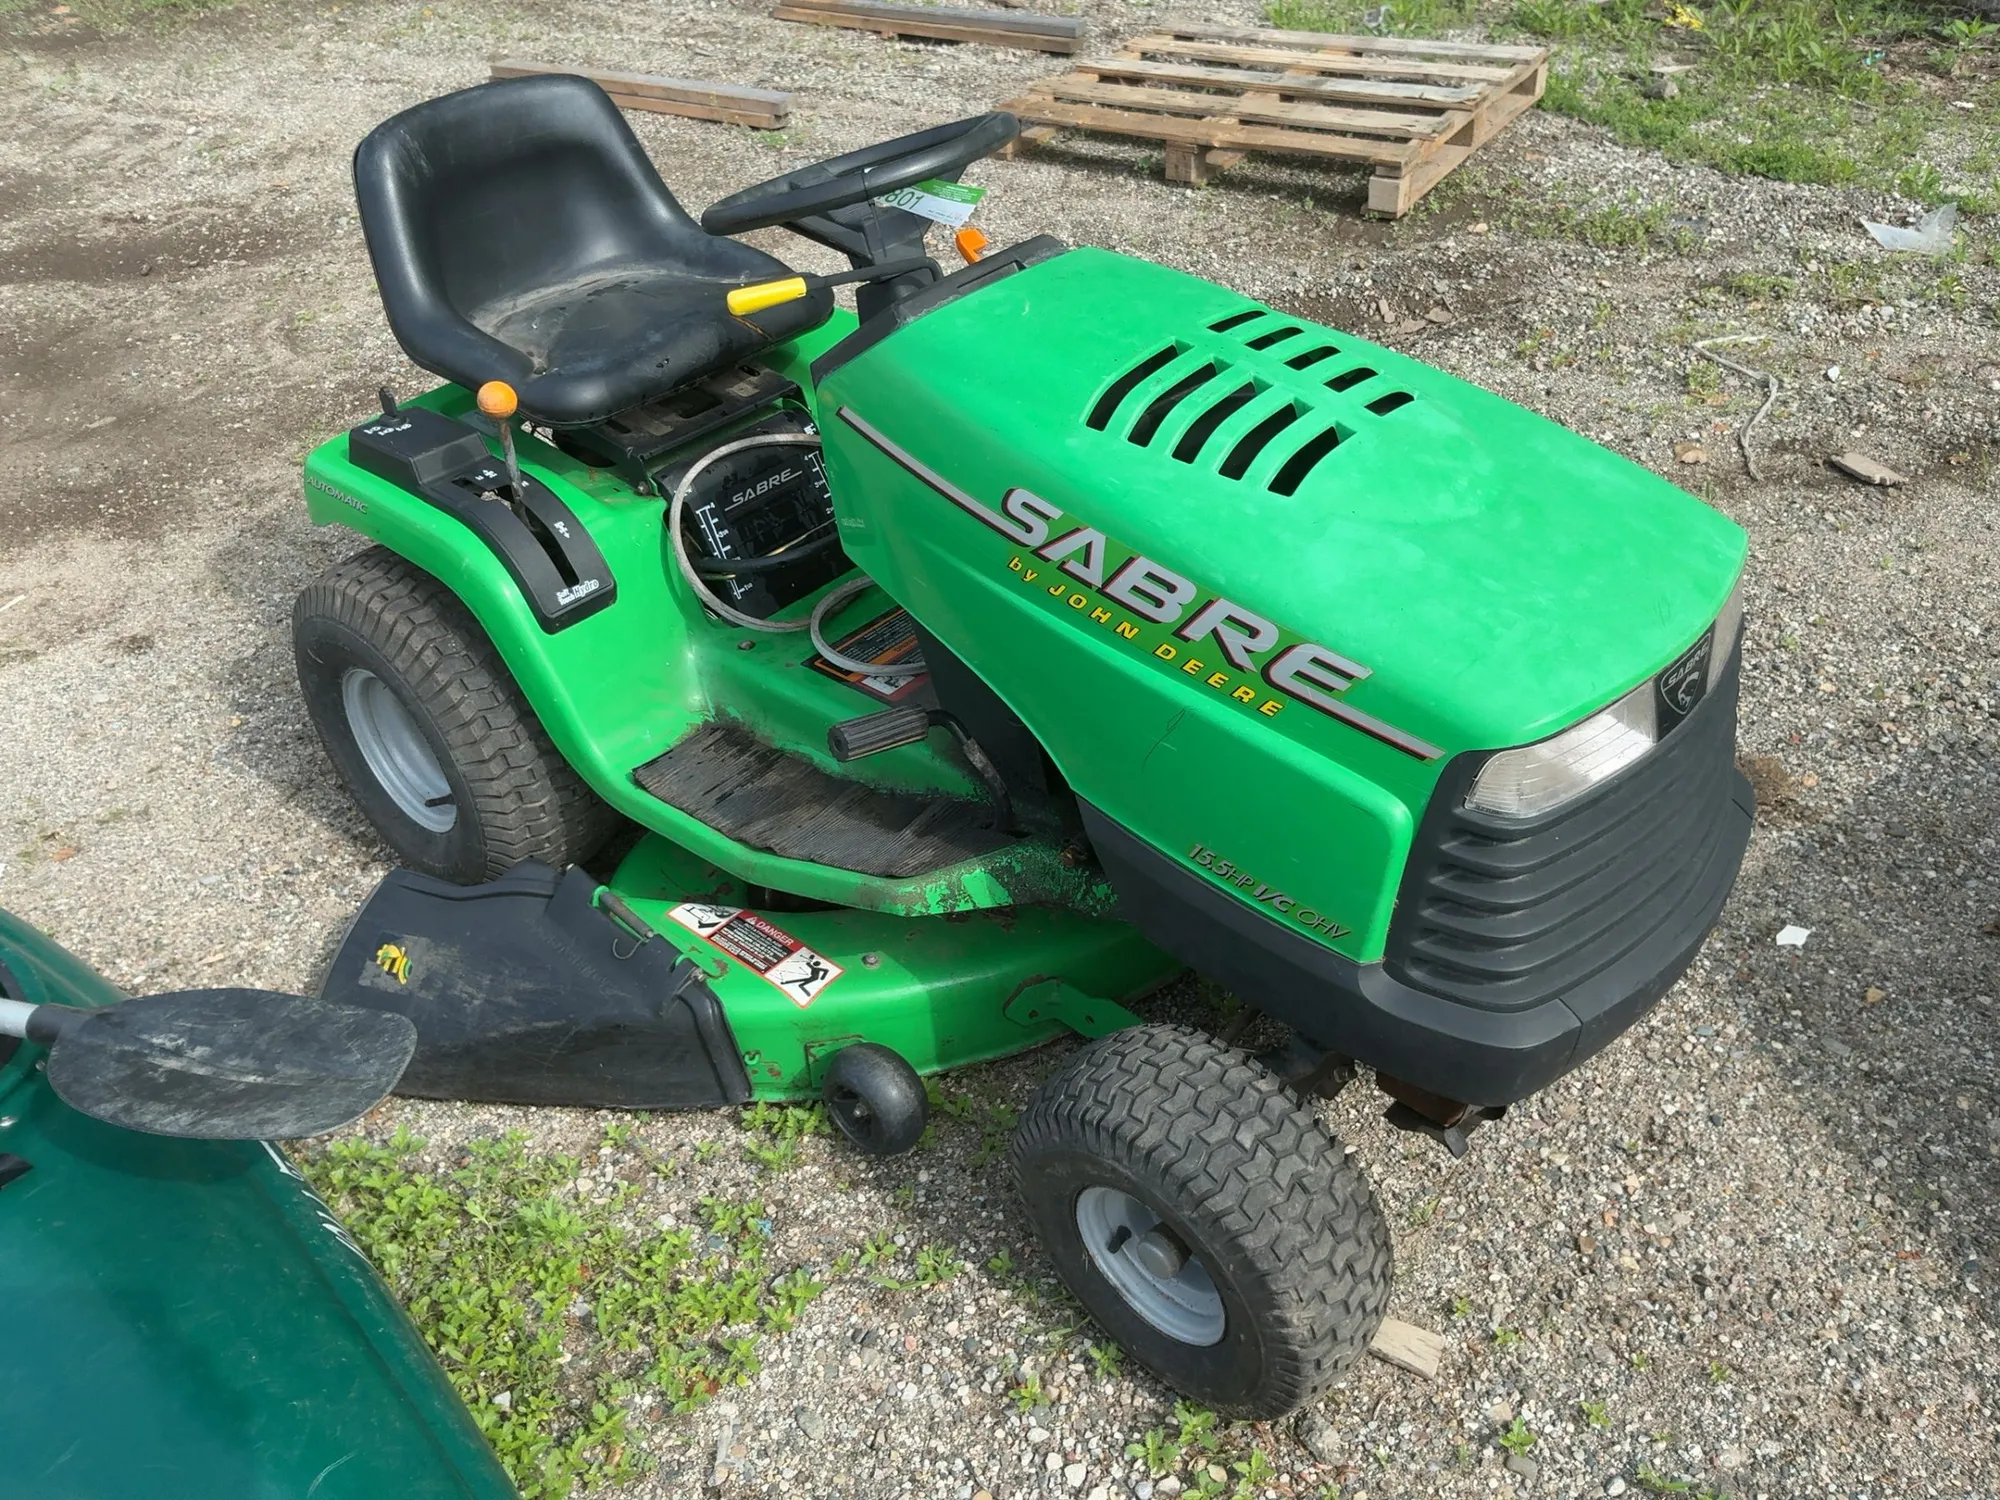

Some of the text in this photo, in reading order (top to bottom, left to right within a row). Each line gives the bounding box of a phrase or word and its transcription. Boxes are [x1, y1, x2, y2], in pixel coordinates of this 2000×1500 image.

[877, 189, 924, 210] 801
[307, 475, 369, 514] AUTOMATIC
[732, 467, 792, 504] SABRE
[573, 579, 600, 597] Hydro
[1001, 487, 1373, 698] SABRE
[1007, 556, 1285, 718] by JOHN DEERE
[1668, 642, 1709, 686] SABRE
[1188, 843, 1255, 888] 15.5HP
[1297, 909, 1351, 939] OHV
[755, 920, 794, 946] DANGER
